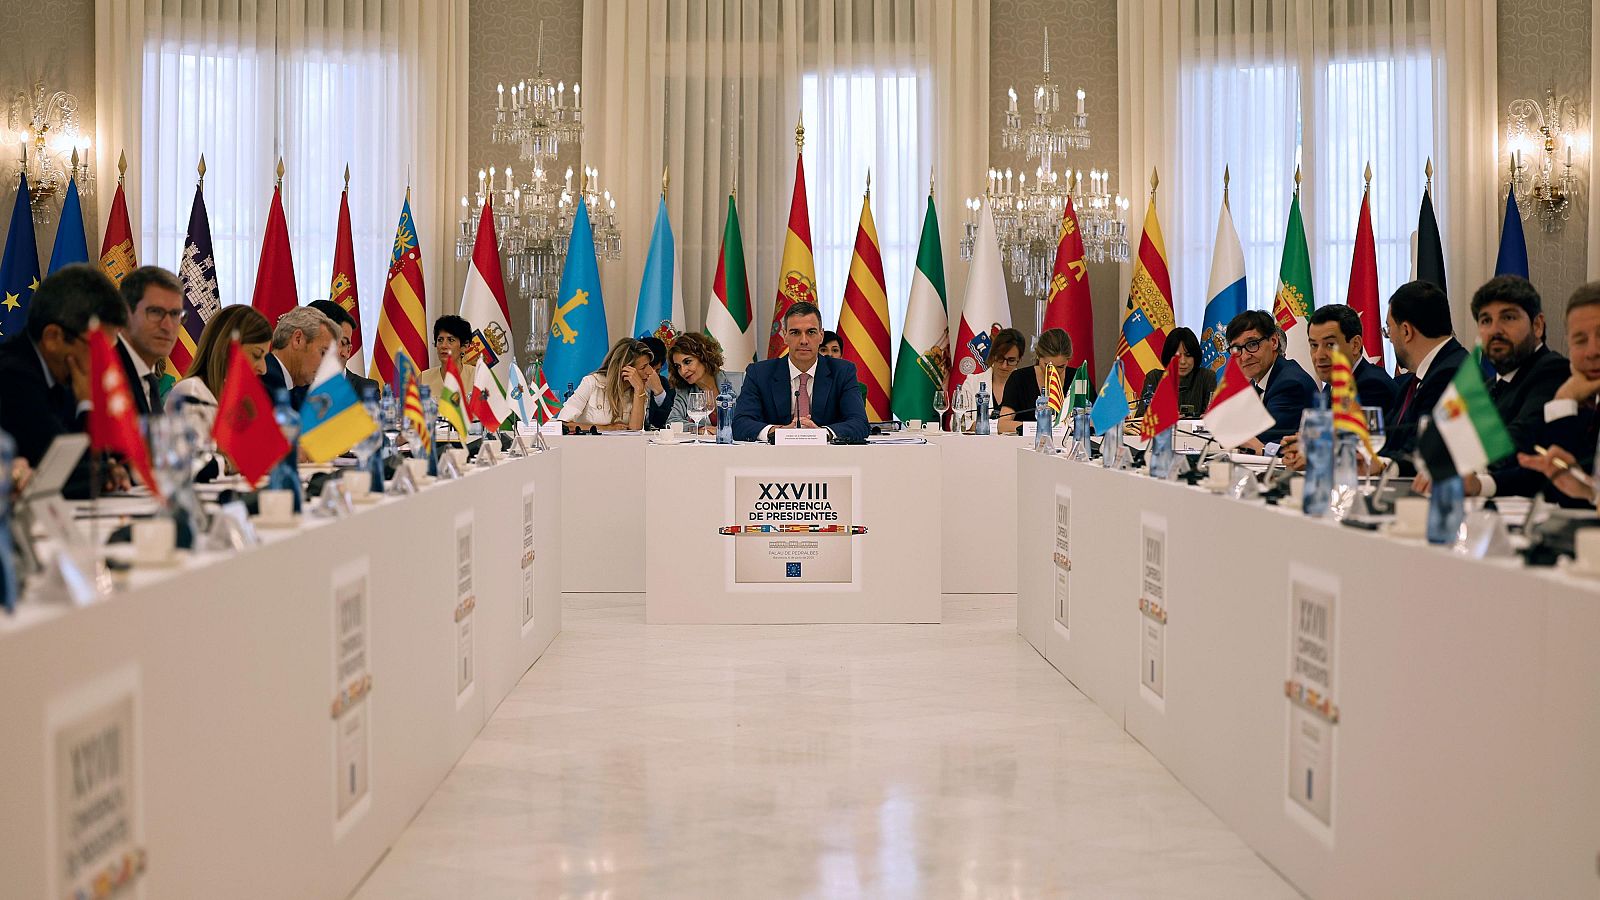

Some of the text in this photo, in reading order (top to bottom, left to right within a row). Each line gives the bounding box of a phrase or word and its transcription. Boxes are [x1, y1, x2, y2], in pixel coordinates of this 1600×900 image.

[758, 483, 828, 500] XXVIII
[754, 501, 832, 511] CONFERENCIA
[749, 511, 838, 521] DE PRESIDENTES
